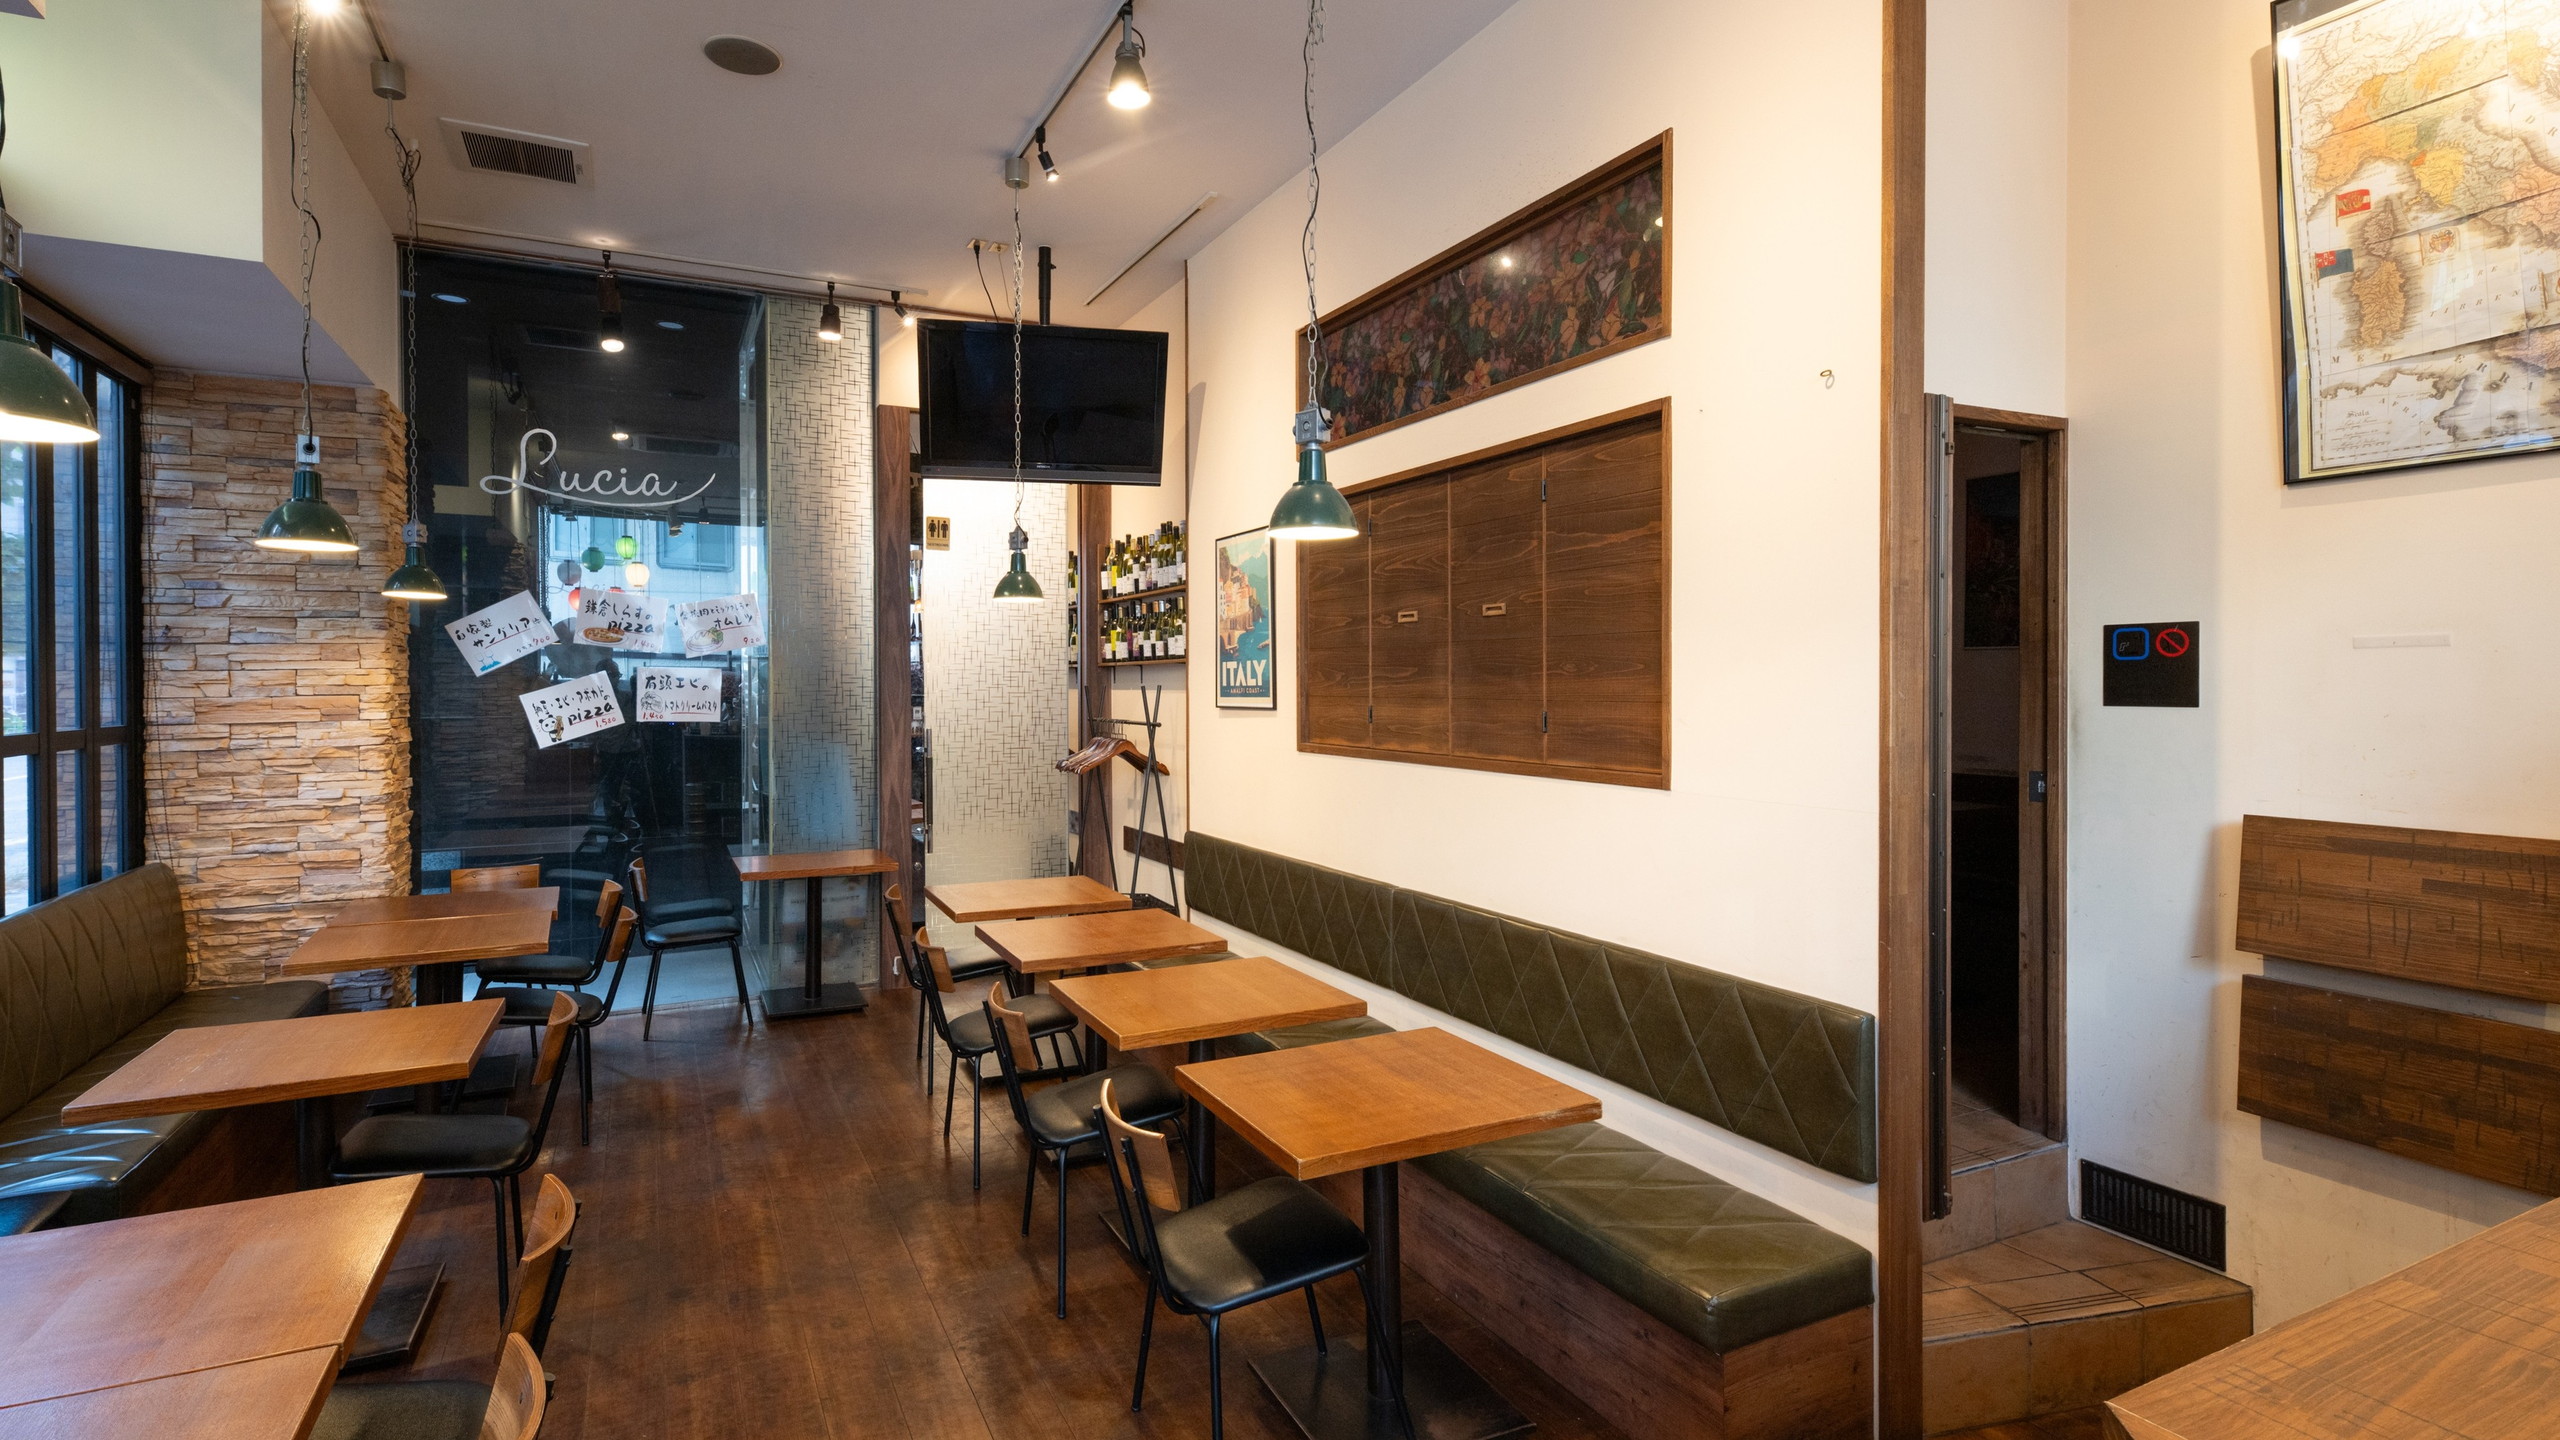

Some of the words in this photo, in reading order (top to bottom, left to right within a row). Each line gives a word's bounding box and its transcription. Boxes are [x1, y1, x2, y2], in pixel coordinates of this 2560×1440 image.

[480, 428, 716, 507] Lucia
[713, 613, 753, 629] オムレツ
[1222, 659, 1267, 686] ITALY
[567, 702, 615, 726] pizza
